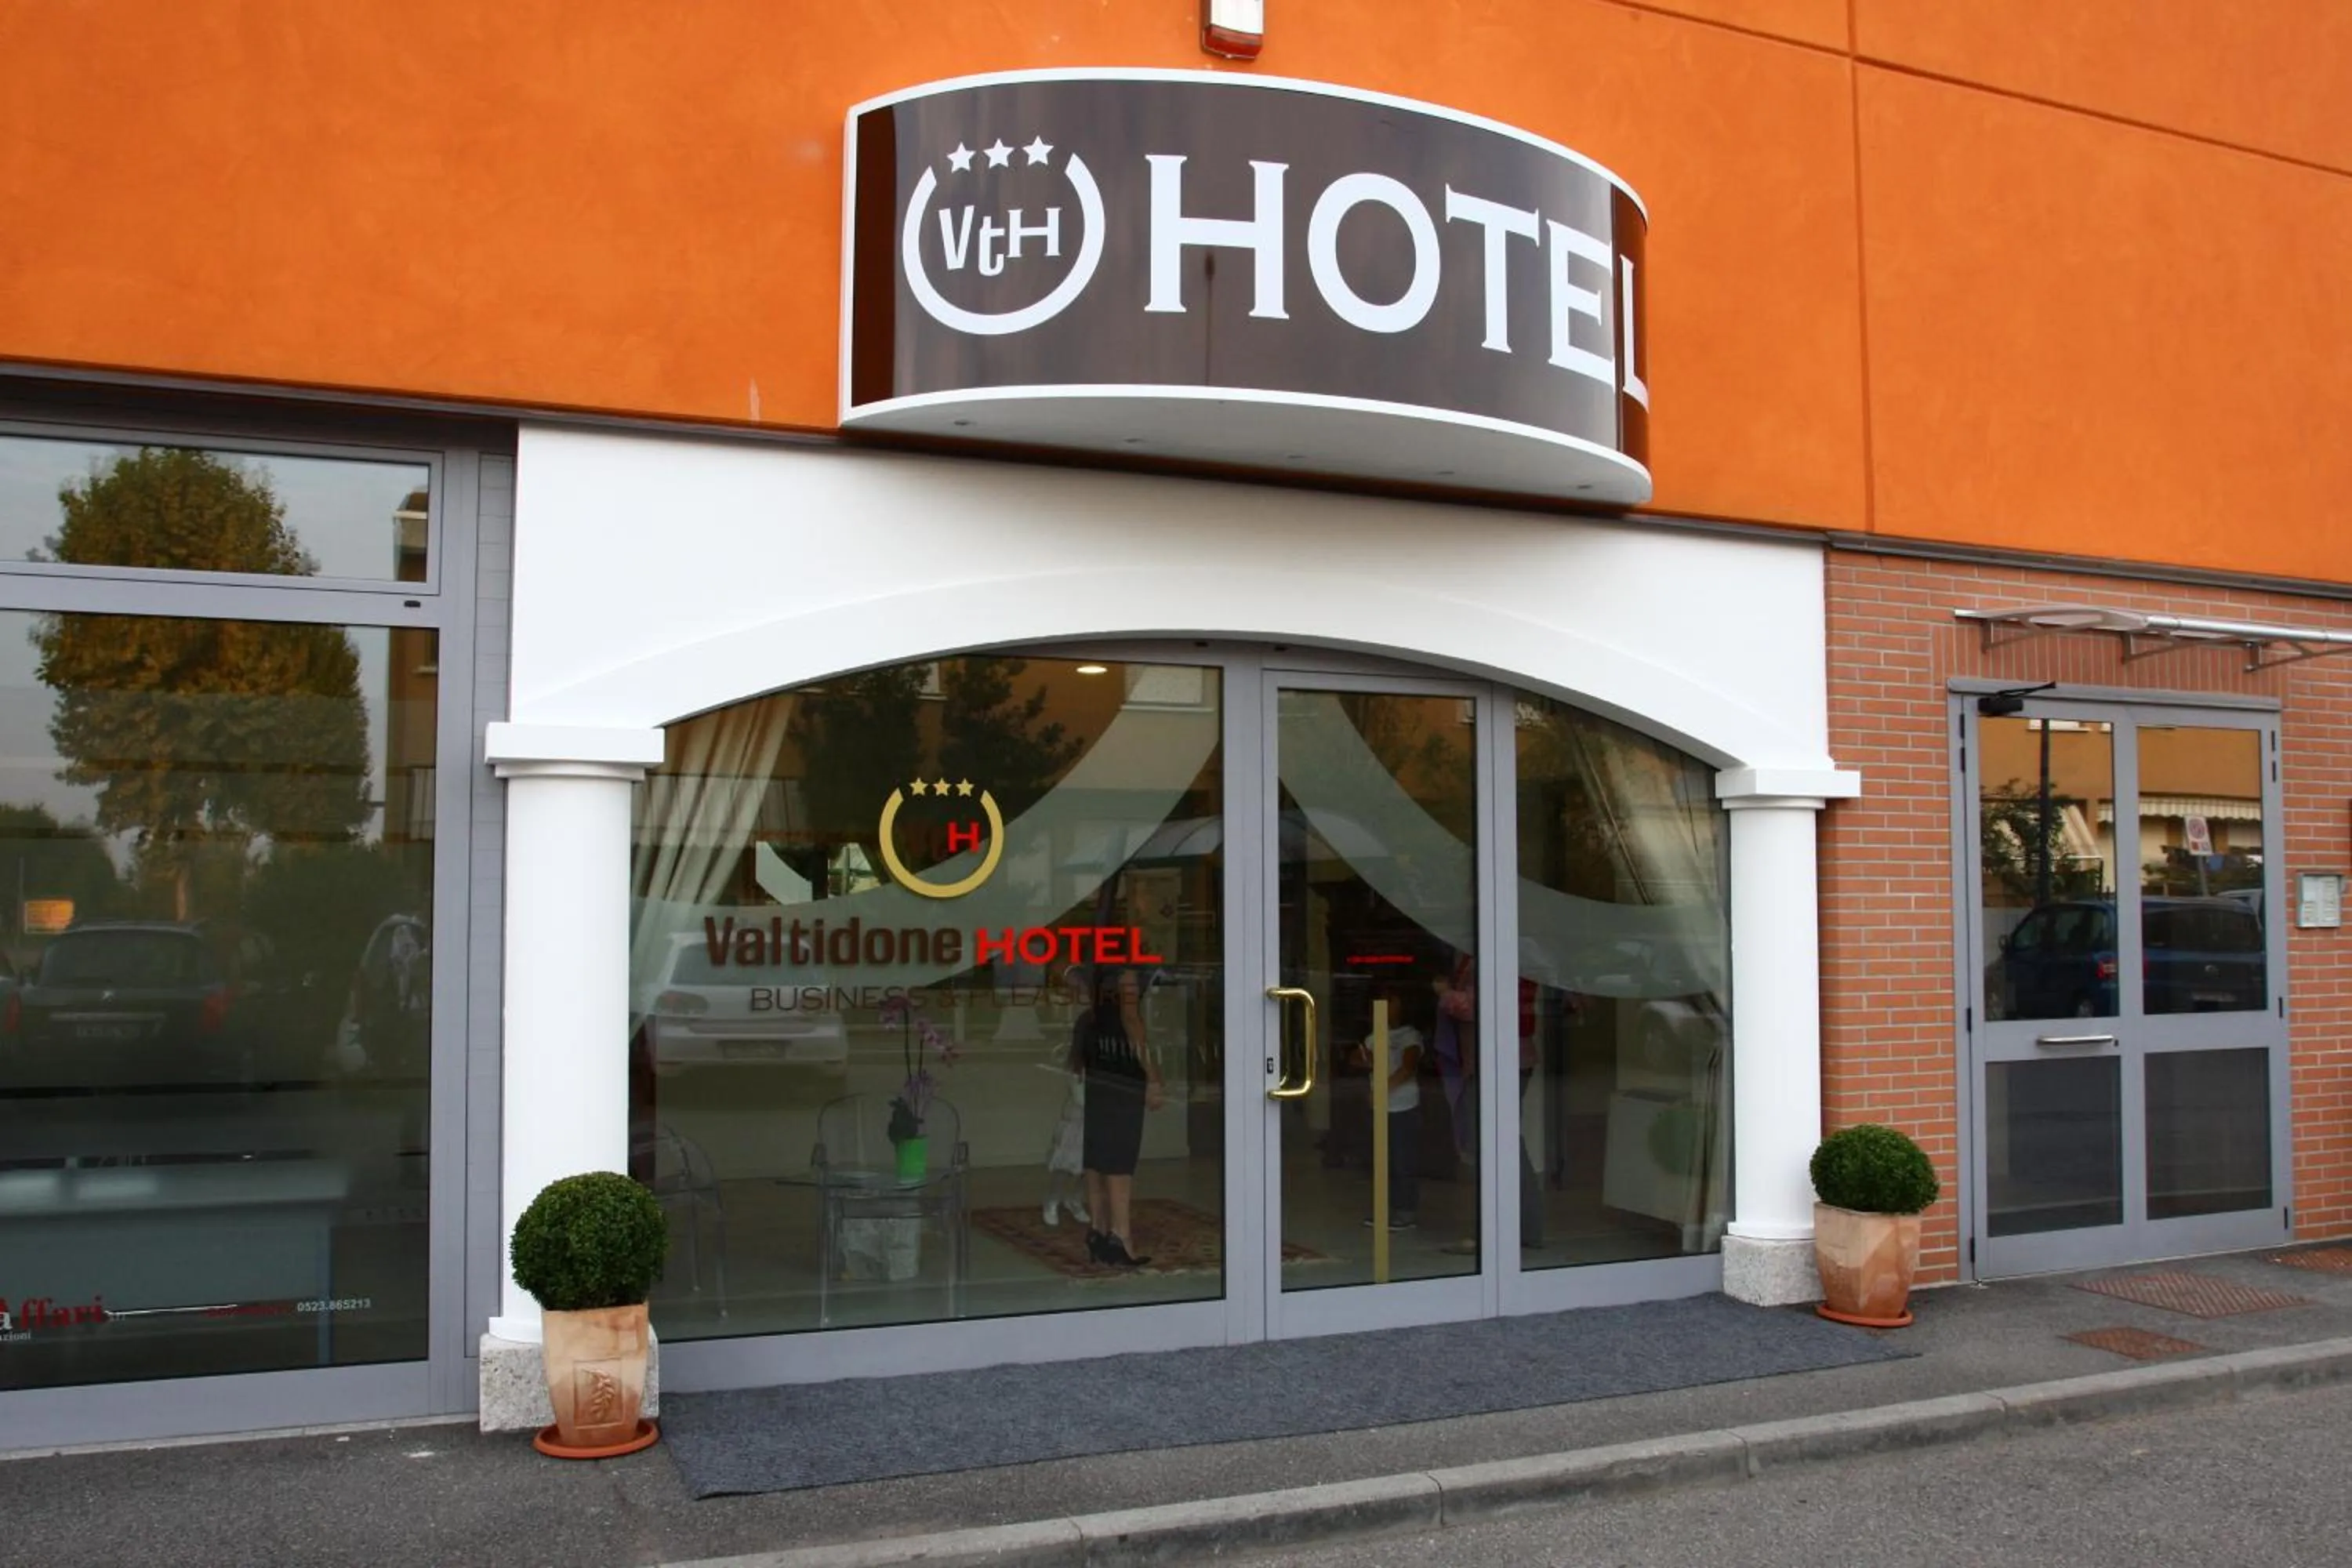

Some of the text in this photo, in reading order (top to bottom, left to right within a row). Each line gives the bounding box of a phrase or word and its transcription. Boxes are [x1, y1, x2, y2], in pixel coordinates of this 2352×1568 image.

[1143, 153, 1650, 414] HOTEL
[702, 915, 1163, 968] Valtidone HOTEL
[750, 985, 928, 1011] BUSINESS
